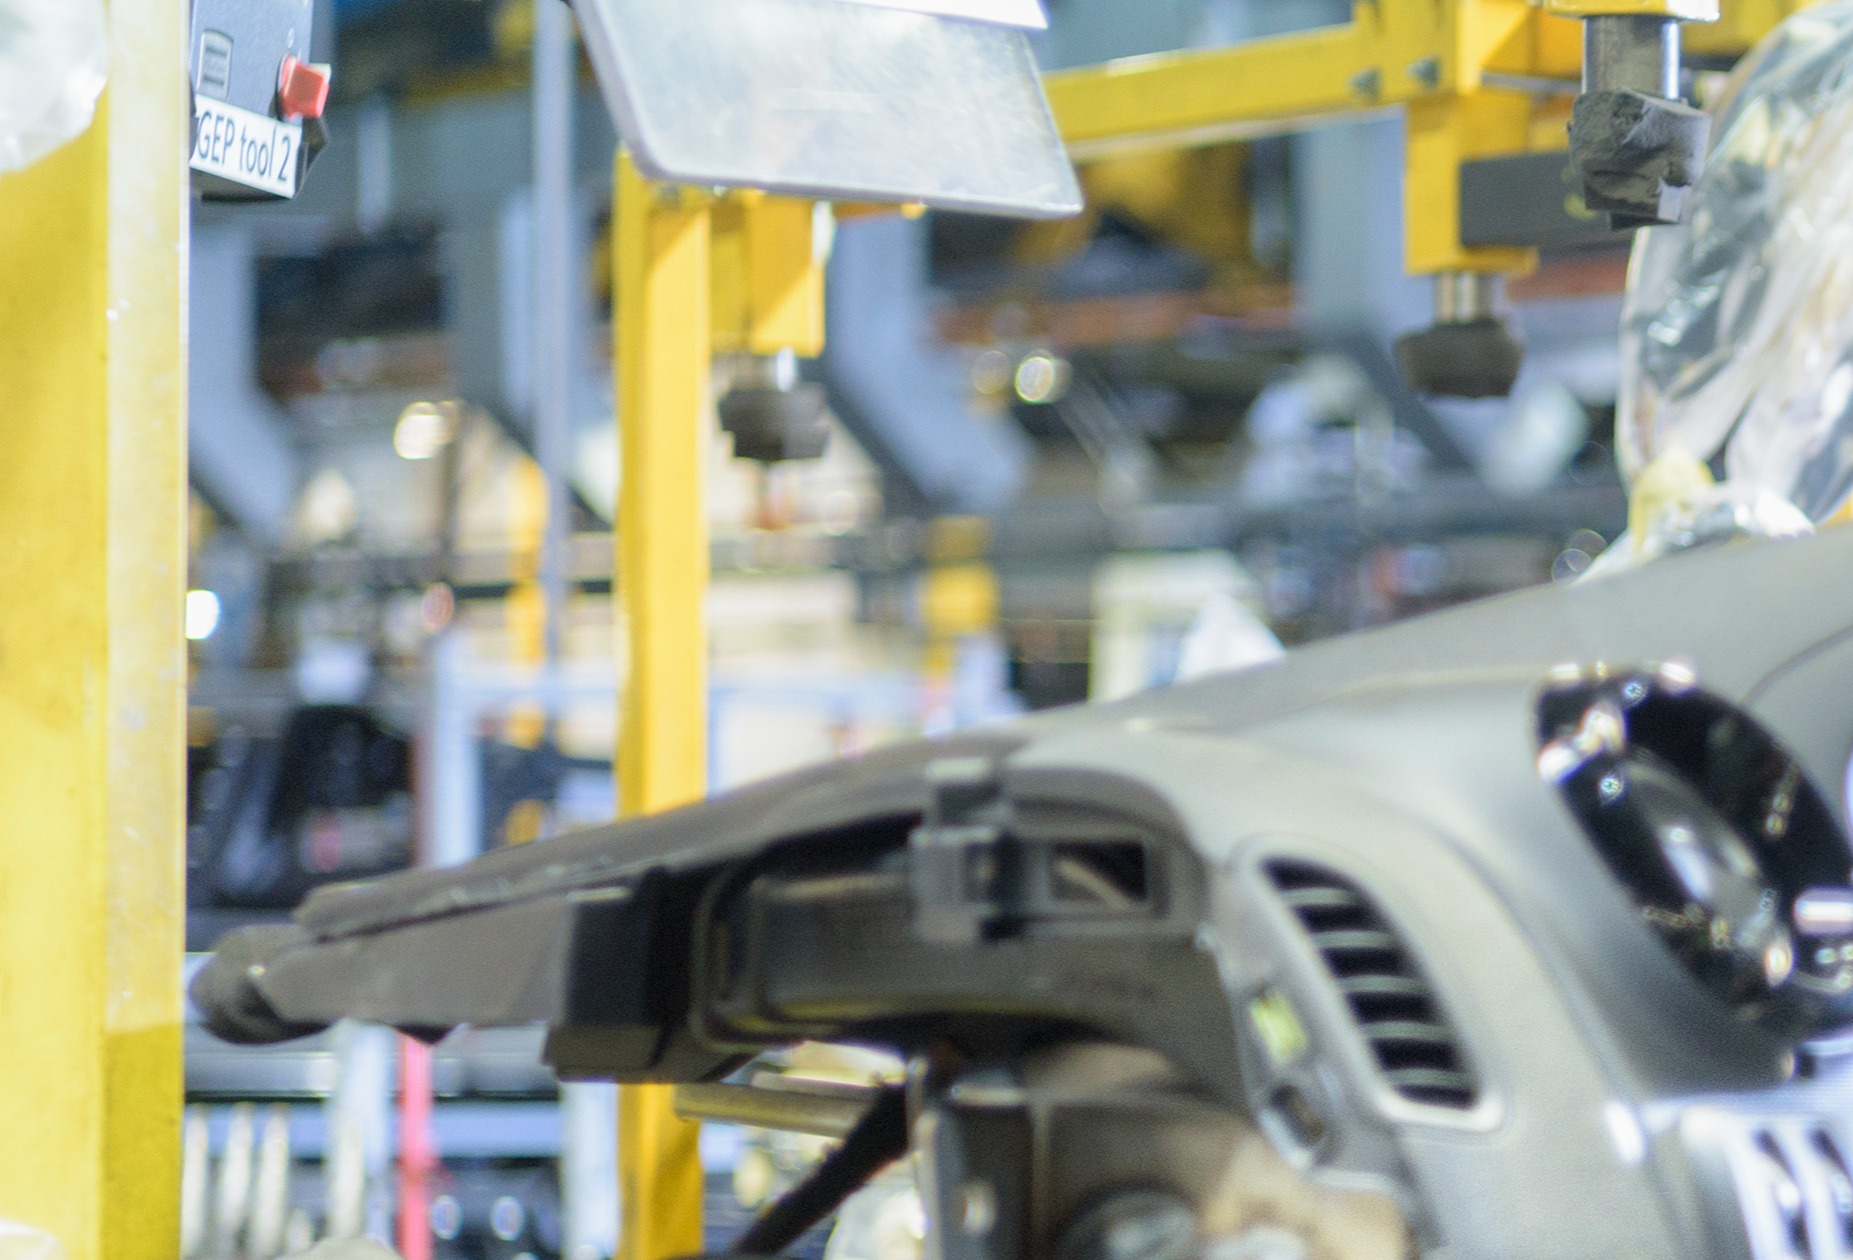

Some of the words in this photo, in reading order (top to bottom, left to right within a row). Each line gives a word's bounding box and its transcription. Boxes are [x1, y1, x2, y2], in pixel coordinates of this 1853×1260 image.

[197, 111, 236, 165] GEP
[239, 124, 278, 177] tool
[277, 136, 292, 182] 2
